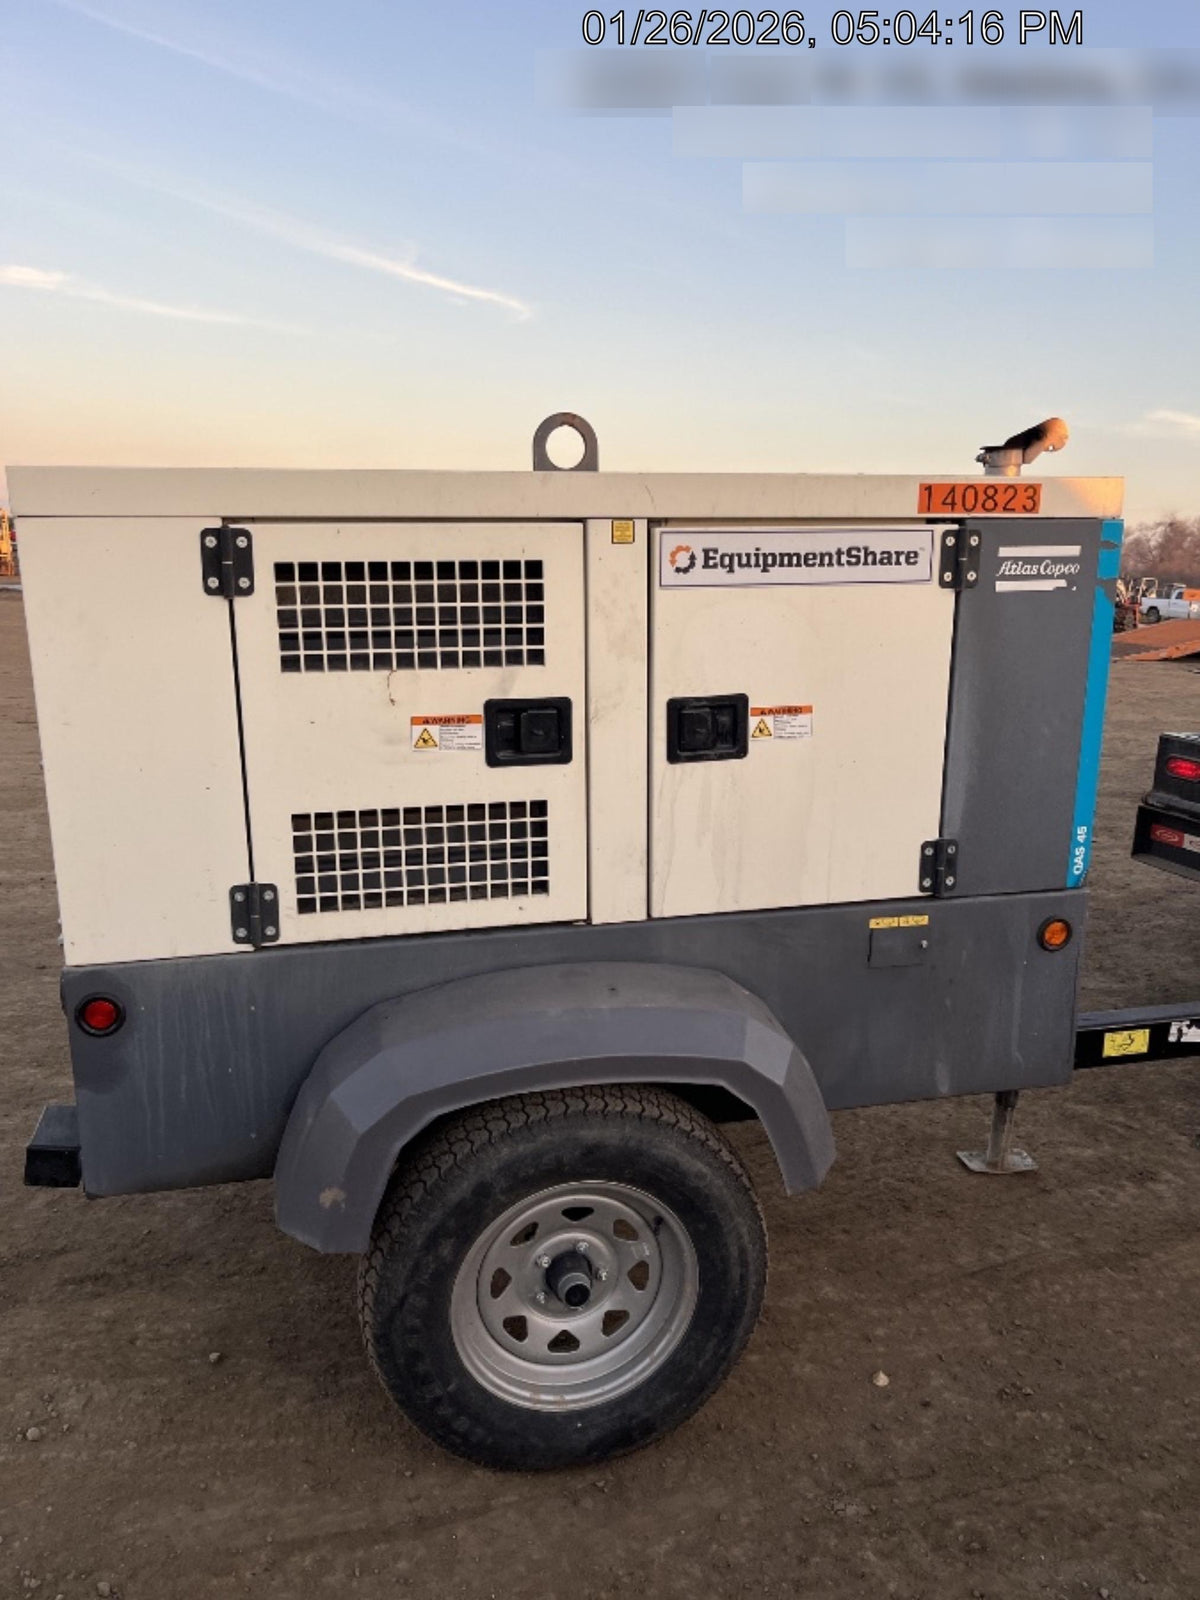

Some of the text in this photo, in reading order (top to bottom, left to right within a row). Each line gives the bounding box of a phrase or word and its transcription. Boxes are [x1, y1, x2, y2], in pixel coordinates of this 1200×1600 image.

[924, 485, 1038, 512] 140823
[702, 546, 919, 573] EquipmentShare
[996, 560, 1080, 577] Atlas Copco
[1077, 826, 1087, 843] 45
